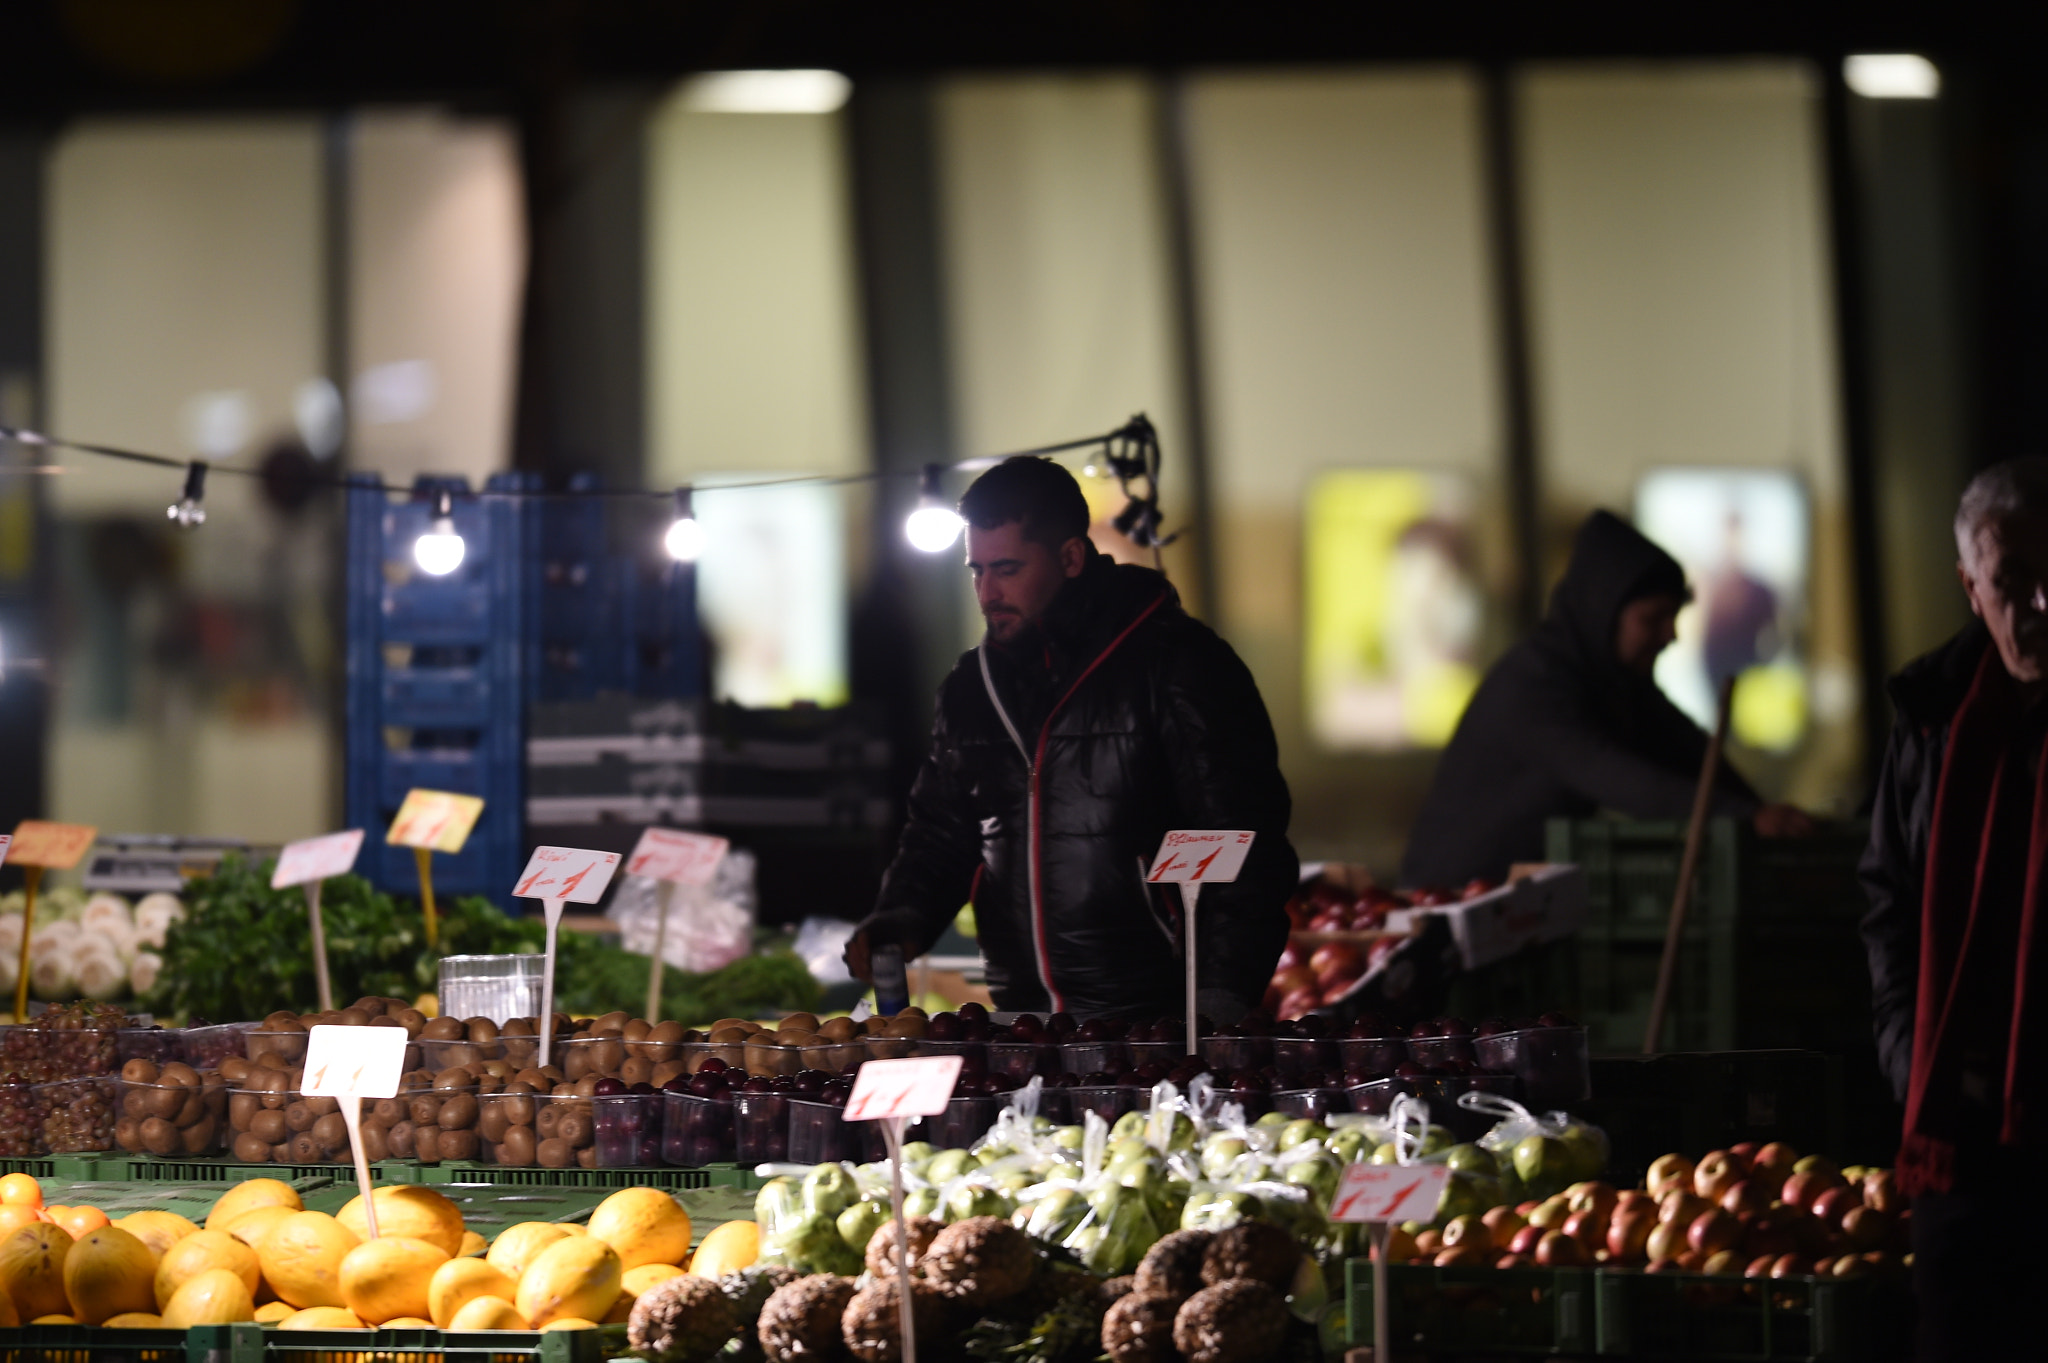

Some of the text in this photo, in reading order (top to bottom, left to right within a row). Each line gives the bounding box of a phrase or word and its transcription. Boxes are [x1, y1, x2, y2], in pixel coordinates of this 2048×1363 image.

[517, 861, 597, 898] 1 1
[1148, 846, 1224, 881] 1 1
[313, 1063, 365, 1092] 1 1
[1333, 1176, 1425, 1217] 1 1
